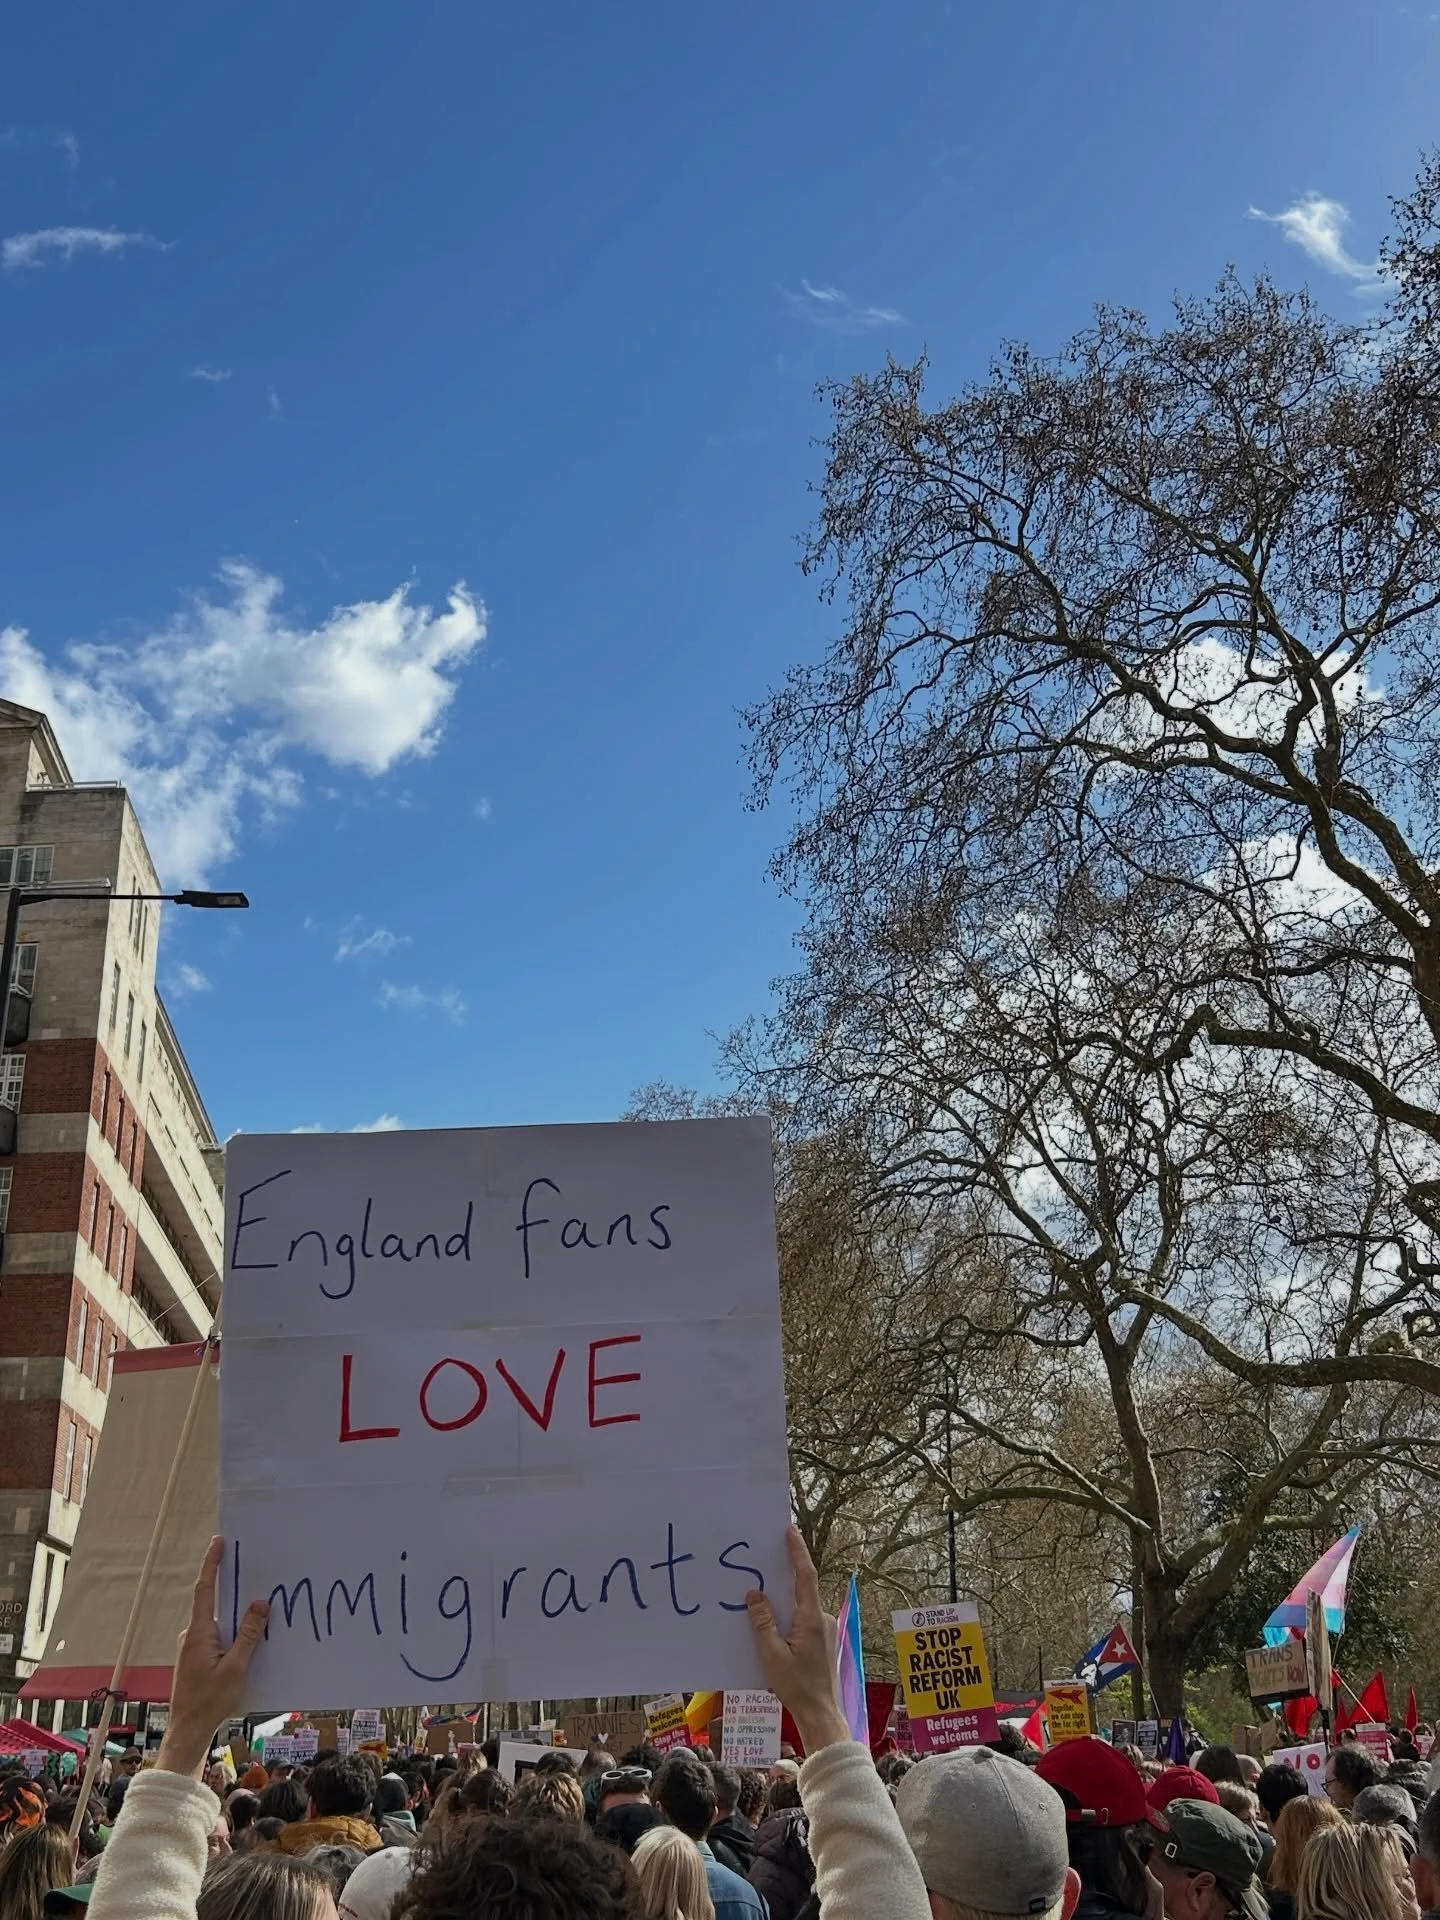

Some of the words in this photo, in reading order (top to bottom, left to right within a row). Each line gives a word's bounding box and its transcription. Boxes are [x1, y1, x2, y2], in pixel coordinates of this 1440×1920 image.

[231, 1170, 472, 1299] England
[515, 1178, 672, 1279] fans
[339, 1335, 641, 1443] LOVE
[231, 1522, 766, 1682] Immigrants
[926, 1608, 945, 1618] STAND
[946, 1608, 955, 1616] UP
[927, 1617, 936, 1626] TO
[936, 1614, 959, 1624] RACISM
[914, 1627, 962, 1650] STOP
[909, 1646, 973, 1673] RACIST
[1246, 1644, 1293, 1668] TRANS
[909, 1665, 982, 1694] REFORM
[726, 1695, 740, 1704] NO
[745, 1694, 779, 1704] RACISM
[935, 1689, 961, 1711] UK
[650, 1706, 683, 1724] Refugees
[725, 1706, 737, 1714] NO
[1050, 1704, 1074, 1713] Together
[1061, 1712, 1071, 1720] can
[1072, 1712, 1084, 1721] stop
[651, 1716, 683, 1734] welcome
[724, 1726, 734, 1734] NO
[926, 1715, 978, 1732] Refugees
[1052, 1720, 1061, 1729] the
[1062, 1720, 1071, 1728] far
[1072, 1719, 1086, 1729] right
[653, 1733, 672, 1747] Stop
[672, 1728, 685, 1740] the
[724, 1737, 733, 1745] NO
[737, 1737, 765, 1746] HATRED
[930, 1729, 979, 1746] welcome
[724, 1746, 740, 1756] YES
[744, 1746, 765, 1755] LOVE
[724, 1756, 739, 1765] YES
